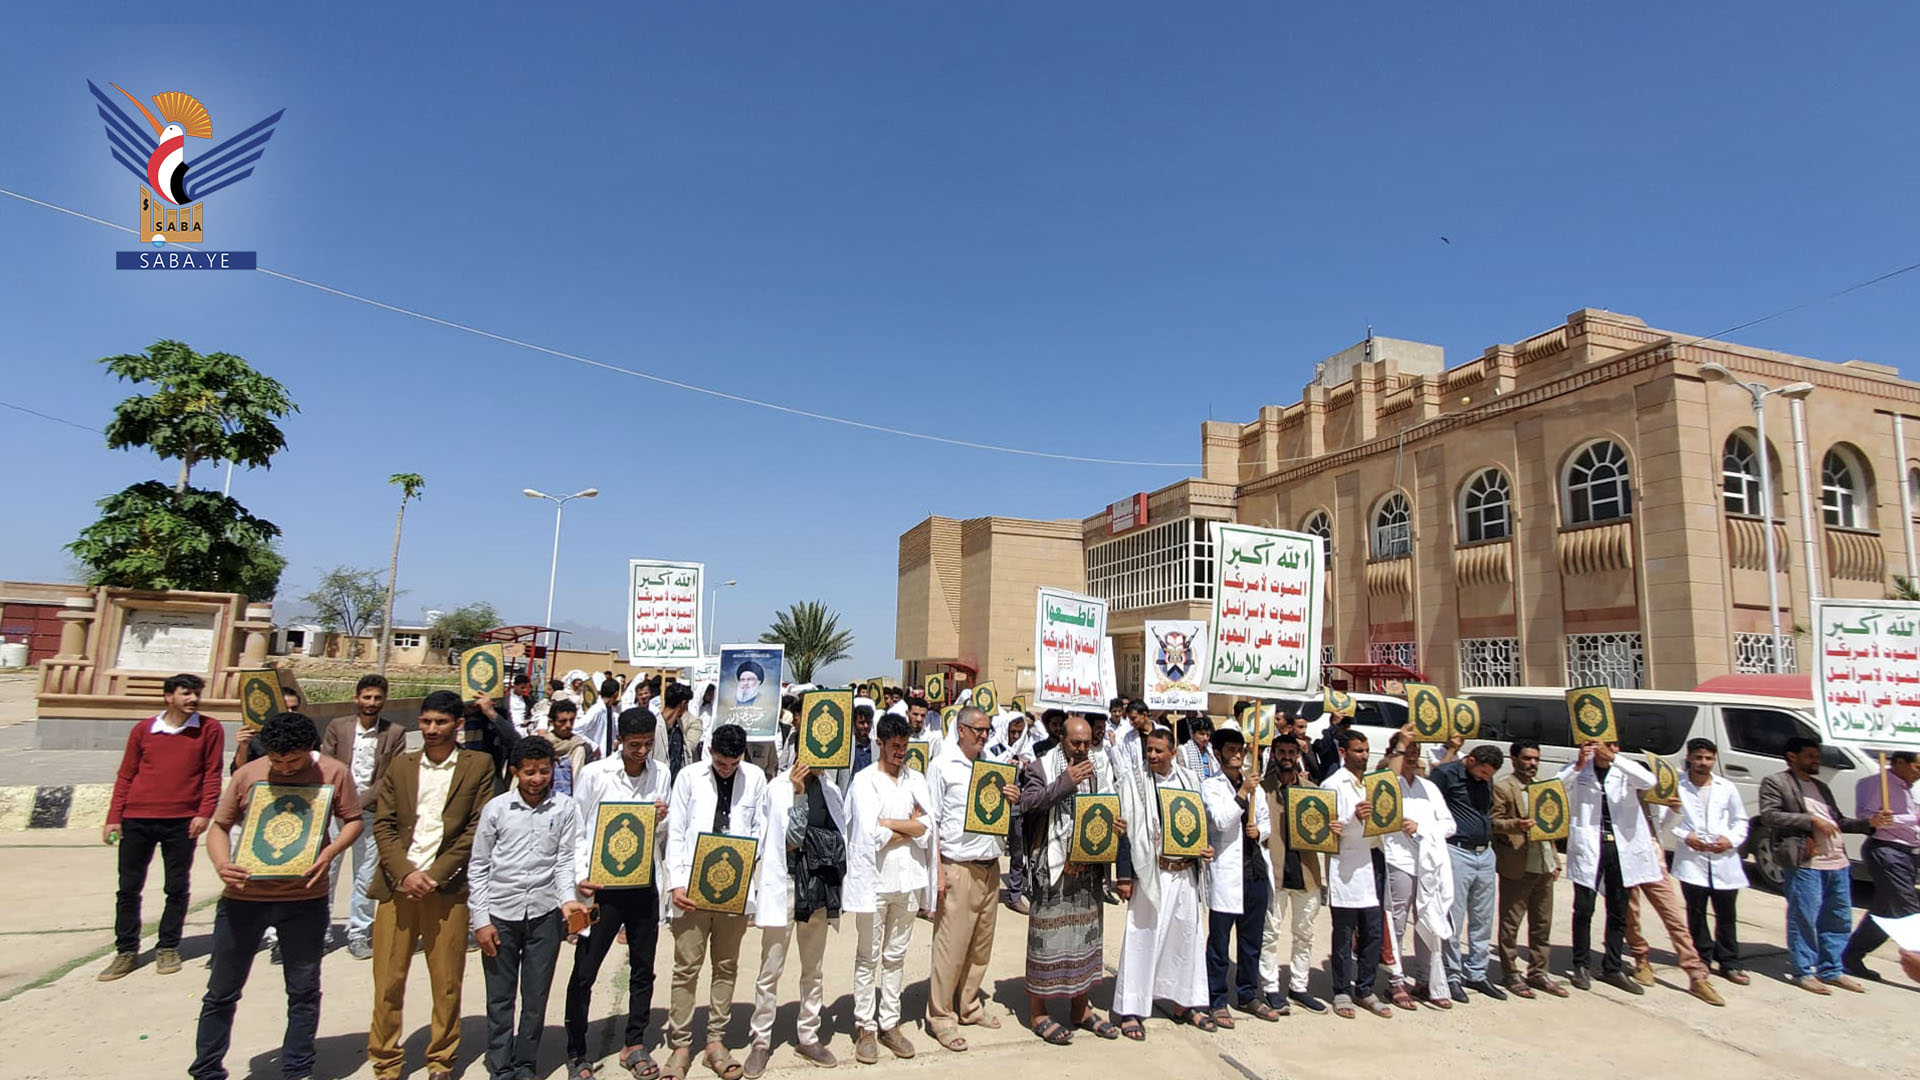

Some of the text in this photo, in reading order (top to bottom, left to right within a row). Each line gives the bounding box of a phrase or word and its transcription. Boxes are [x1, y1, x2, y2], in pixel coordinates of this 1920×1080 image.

[1225, 538, 1309, 570] الله أكبر
[638, 570, 695, 590] الله أكبر
[1270, 580, 1307, 598] الموت
[671, 593, 695, 604] الموت
[671, 608, 694, 620] الموت
[1269, 606, 1306, 625] الموت
[637, 623, 694, 636] اللعنة على اليهود
[1825, 610, 1883, 640] أكبر
[670, 637, 695, 654] النصر
[1075, 636, 1098, 658] البضائع
[1219, 627, 1305, 650] اللعنة على اليهود
[1216, 651, 1304, 682] النصر للإسلام
[1828, 690, 1866, 708] اليهود
[1872, 691, 1892, 708] على
[1832, 711, 1884, 737] للإسلام
